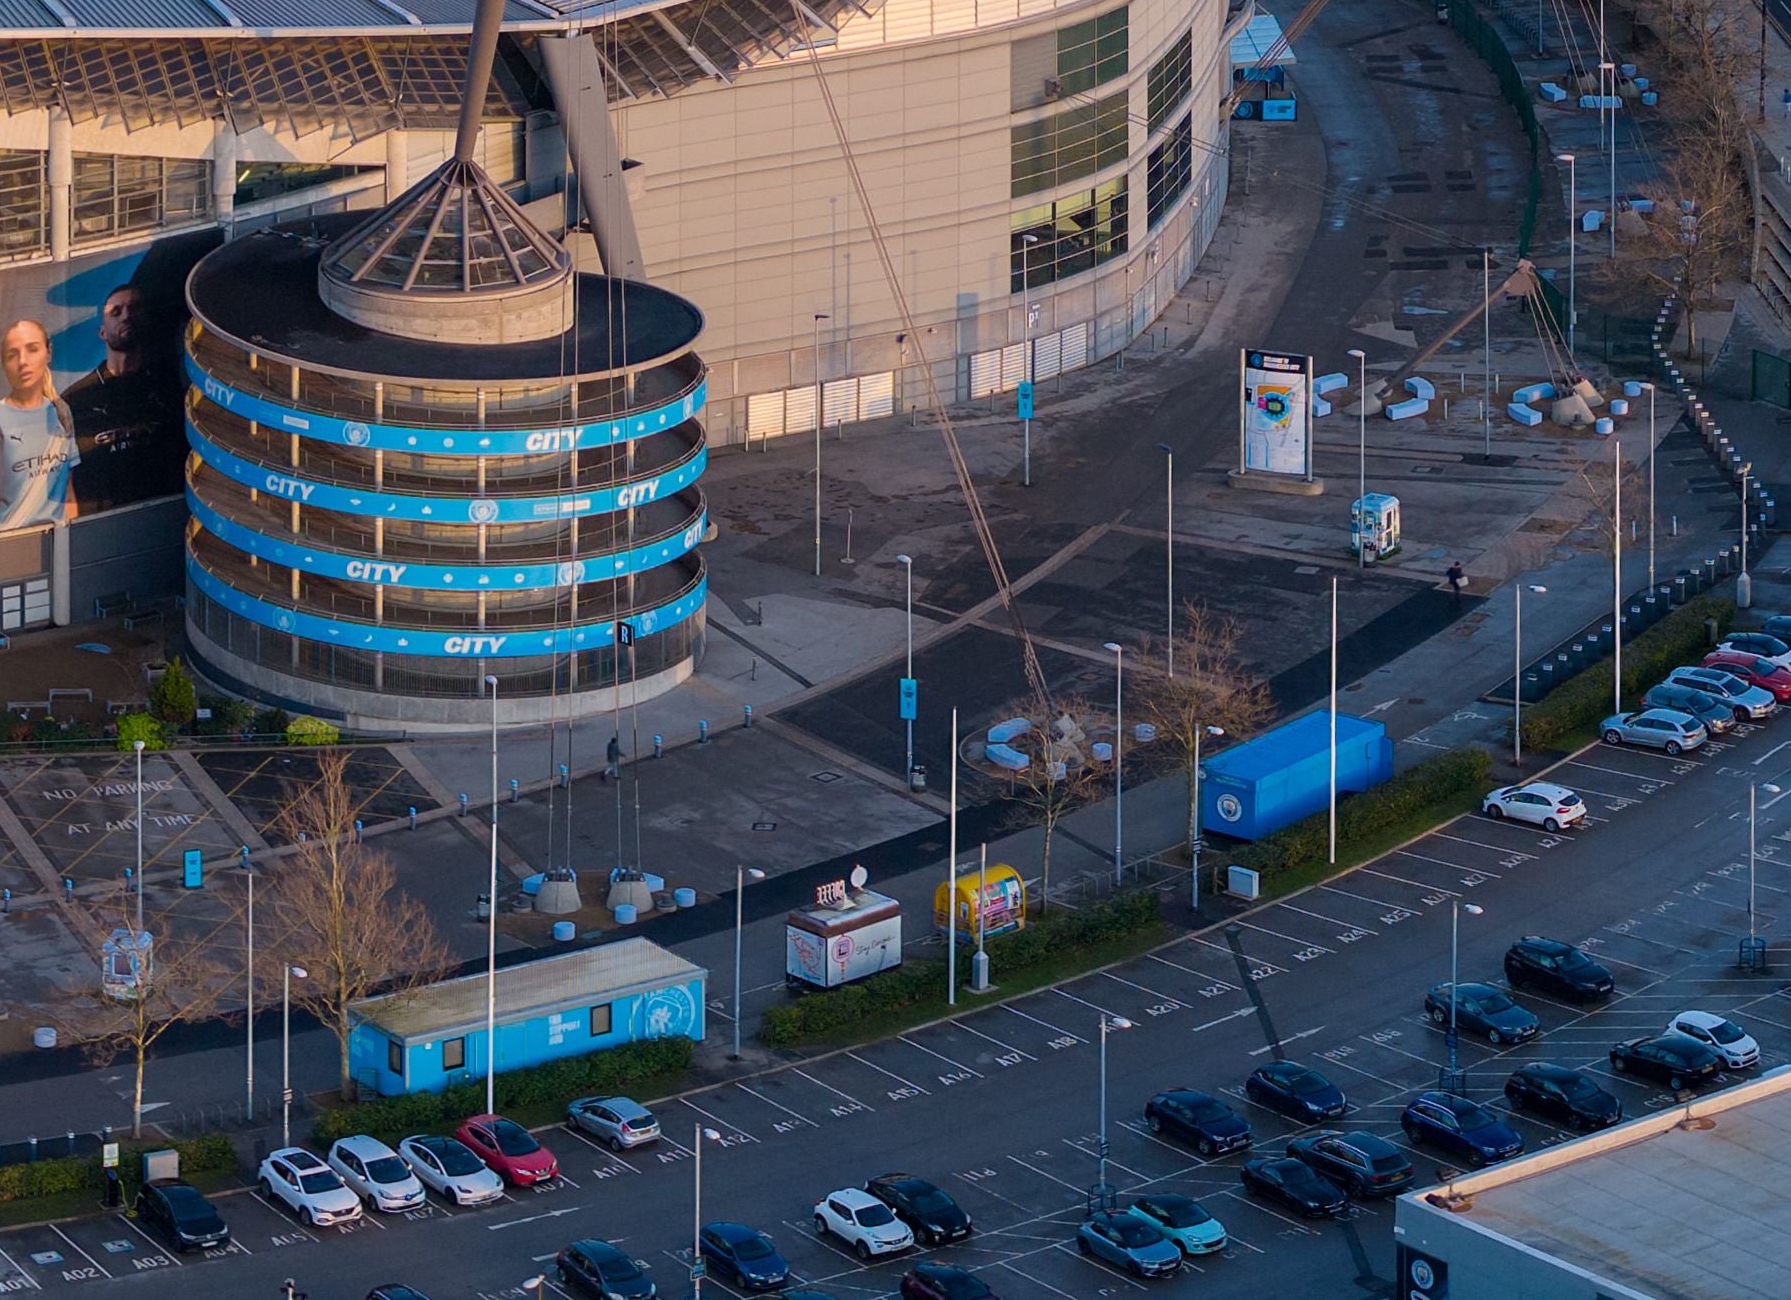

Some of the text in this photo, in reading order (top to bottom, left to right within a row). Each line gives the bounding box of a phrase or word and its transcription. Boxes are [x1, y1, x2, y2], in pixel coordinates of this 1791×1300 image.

[204, 377, 235, 406] CITY
[525, 429, 584, 451] CITY
[11, 453, 68, 473] ETIHAD
[266, 474, 314, 501] CITY
[617, 479, 660, 506] CITY
[346, 559, 407, 583] CITY
[620, 625, 629, 643] R
[444, 636, 508, 654] CITY
[42, 780, 173, 802] NO PARKING
[67, 813, 196, 835] AT ANY TIME
[1198, 983, 1231, 999] A21
[1145, 1001, 1181, 1018] A20
[938, 1071, 972, 1086] A16
[886, 1087, 919, 1101] A15
[270, 1231, 308, 1247] A05
[131, 1254, 170, 1270] A03
[61, 1266, 100, 1282] A02
